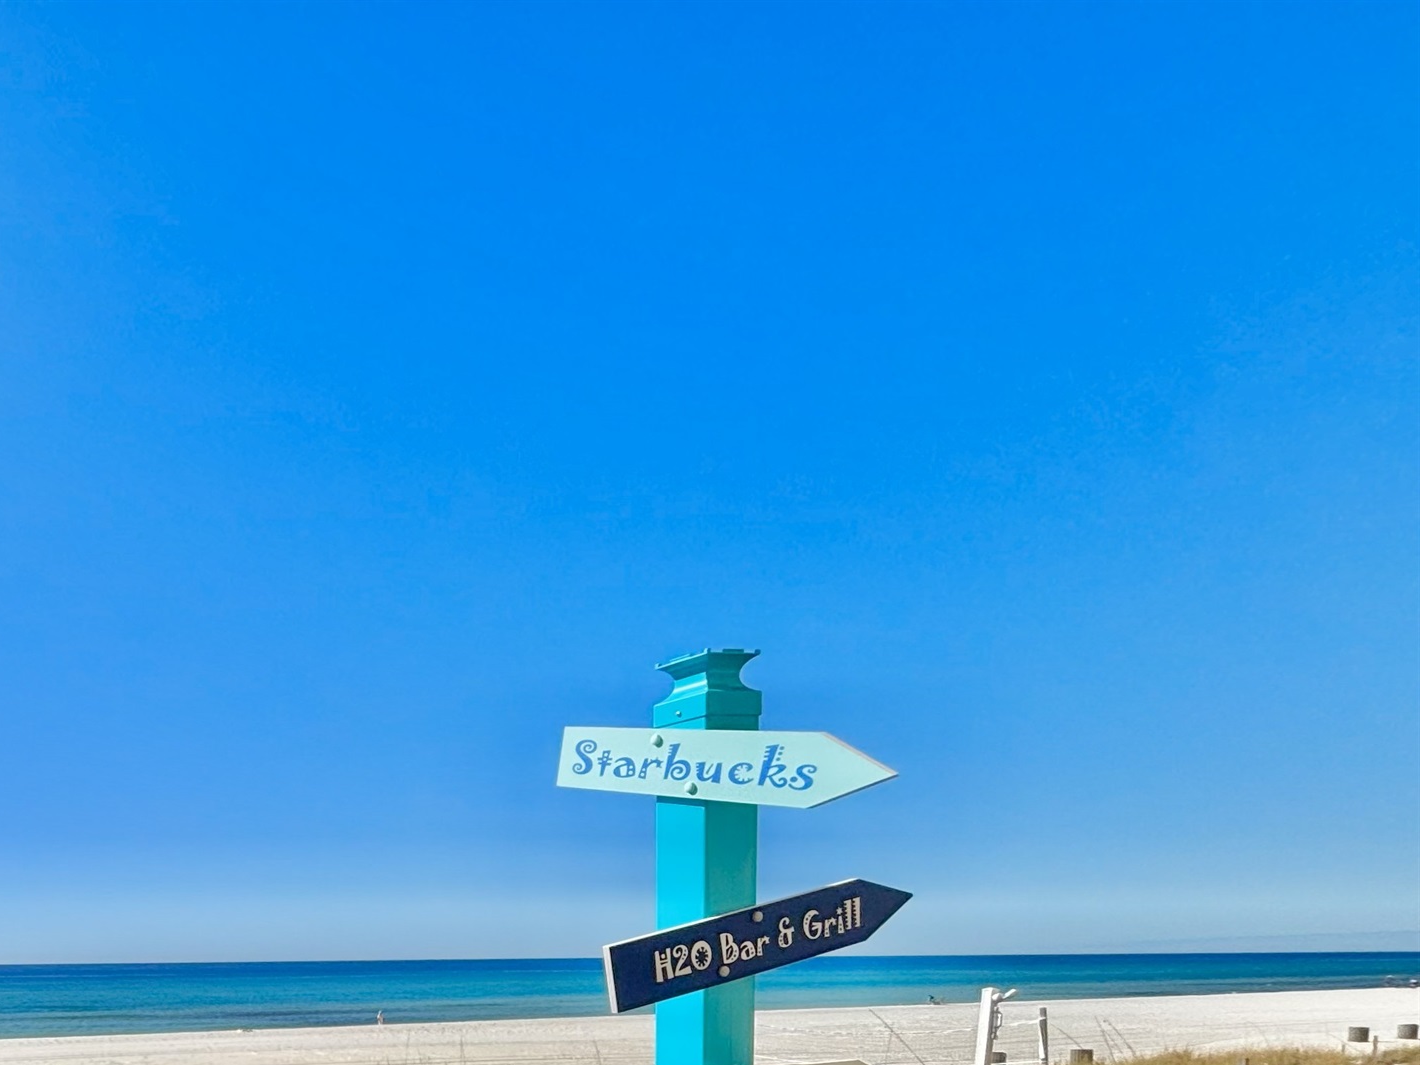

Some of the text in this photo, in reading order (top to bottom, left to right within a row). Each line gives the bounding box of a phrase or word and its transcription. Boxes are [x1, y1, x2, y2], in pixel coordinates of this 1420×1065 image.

[572, 740, 818, 790] Starbucks
[719, 932, 771, 965] Bar
[778, 917, 795, 950] &
[802, 896, 862, 941] Grill
